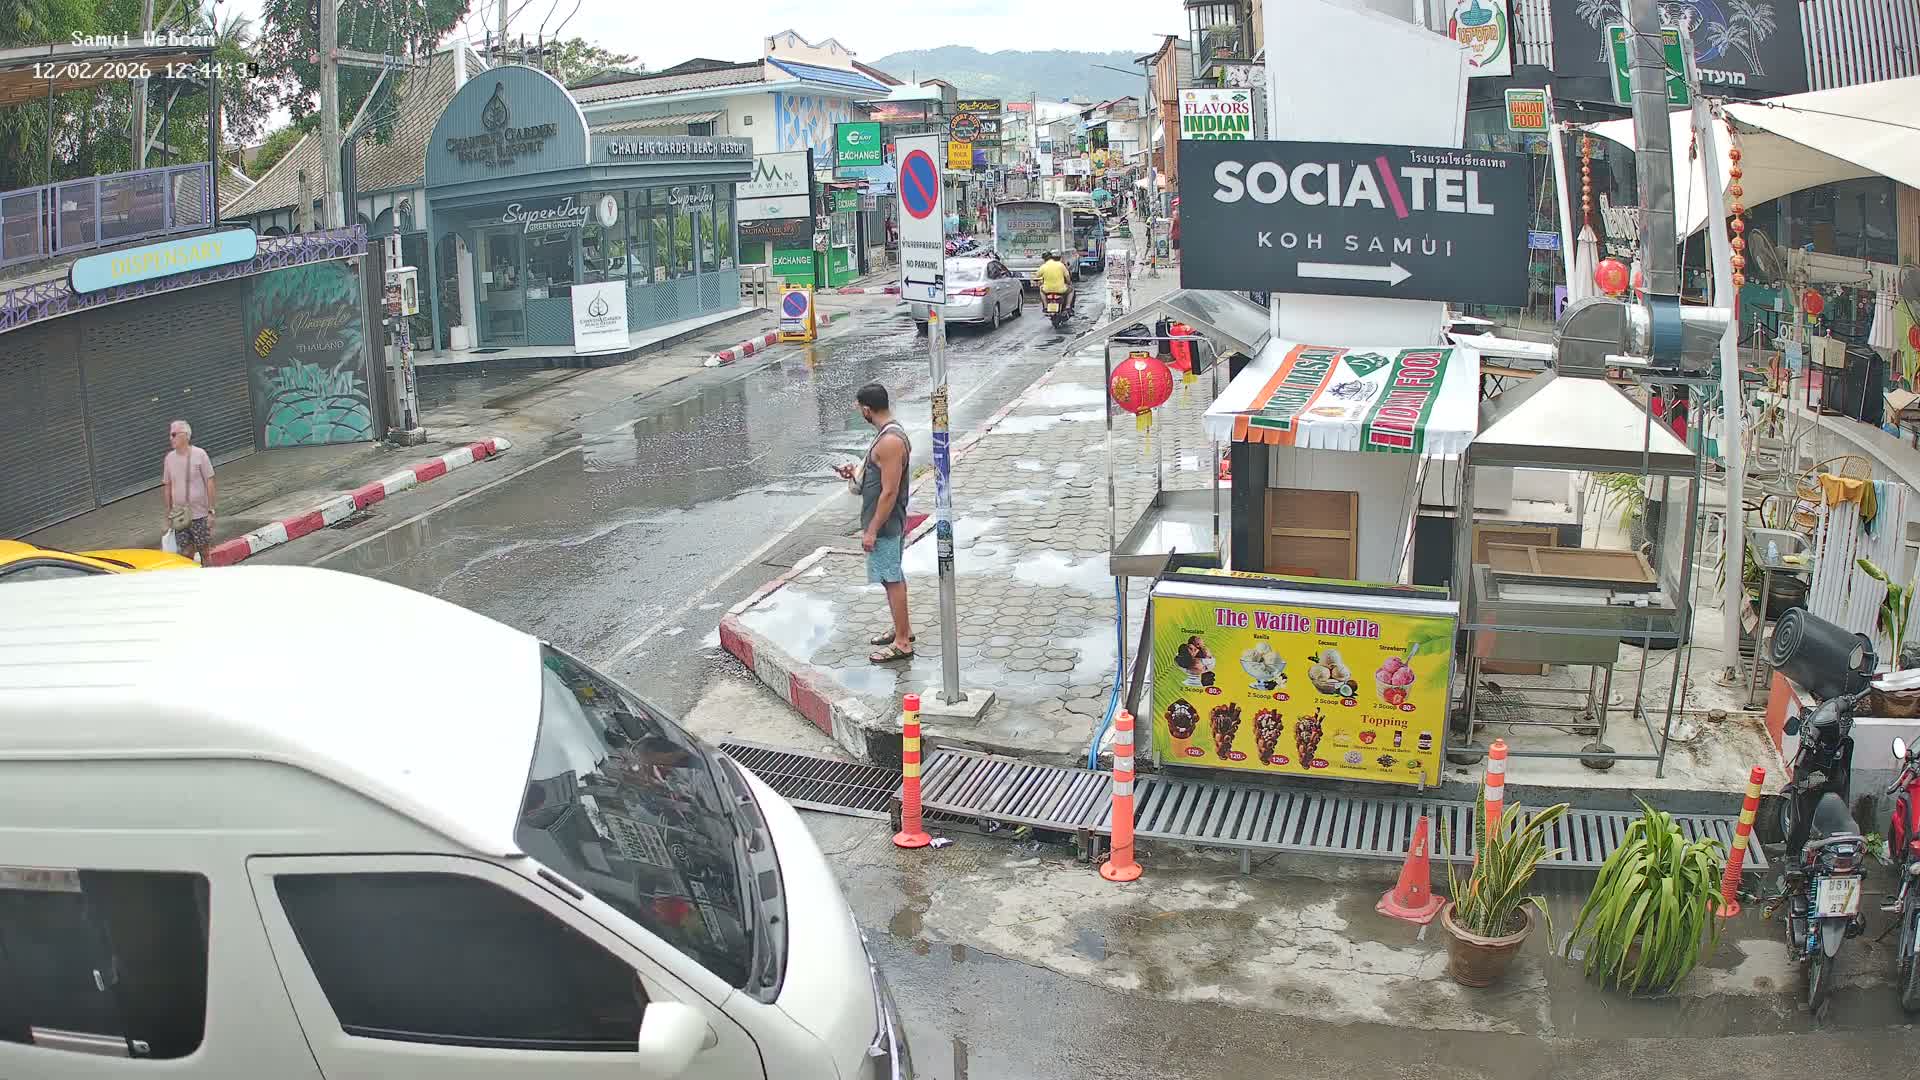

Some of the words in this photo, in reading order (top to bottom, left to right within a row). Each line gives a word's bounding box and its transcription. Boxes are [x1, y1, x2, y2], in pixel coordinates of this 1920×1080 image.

[1185, 103, 1249, 115] FLAVORS
[1511, 101, 1543, 113] INDIAN
[1184, 115, 1249, 132] INDIAN
[1513, 114, 1542, 127] FOOD
[505, 123, 557, 141] GARDEN
[611, 142, 655, 154] CHAWENG
[658, 142, 691, 154] GARDEN
[693, 141, 718, 154] BEACH
[720, 142, 747, 154] RESORT
[839, 151, 880, 160] EXCHANGE
[502, 197, 590, 234] SuperJay
[1258, 231, 1322, 249] KOH
[1345, 233, 1451, 256] SAMUI
[111, 239, 223, 279] DISPENSARY
[774, 256, 812, 265] EXCHANGE
[906, 260, 914, 268] NO
[915, 260, 938, 270] PARKING
[1780, 325, 1809, 344] OPN
[297, 340, 344, 353] THAILAND
[1369, 390, 1430, 448] INDIAN
[1215, 608, 1248, 627] The
[1254, 611, 1309, 633] Waffle
[1315, 618, 1380, 639] nutella
[1379, 645, 1407, 653] Strawberry
[1379, 703, 1397, 711] Scoop
[1361, 715, 1409, 729] Topping
